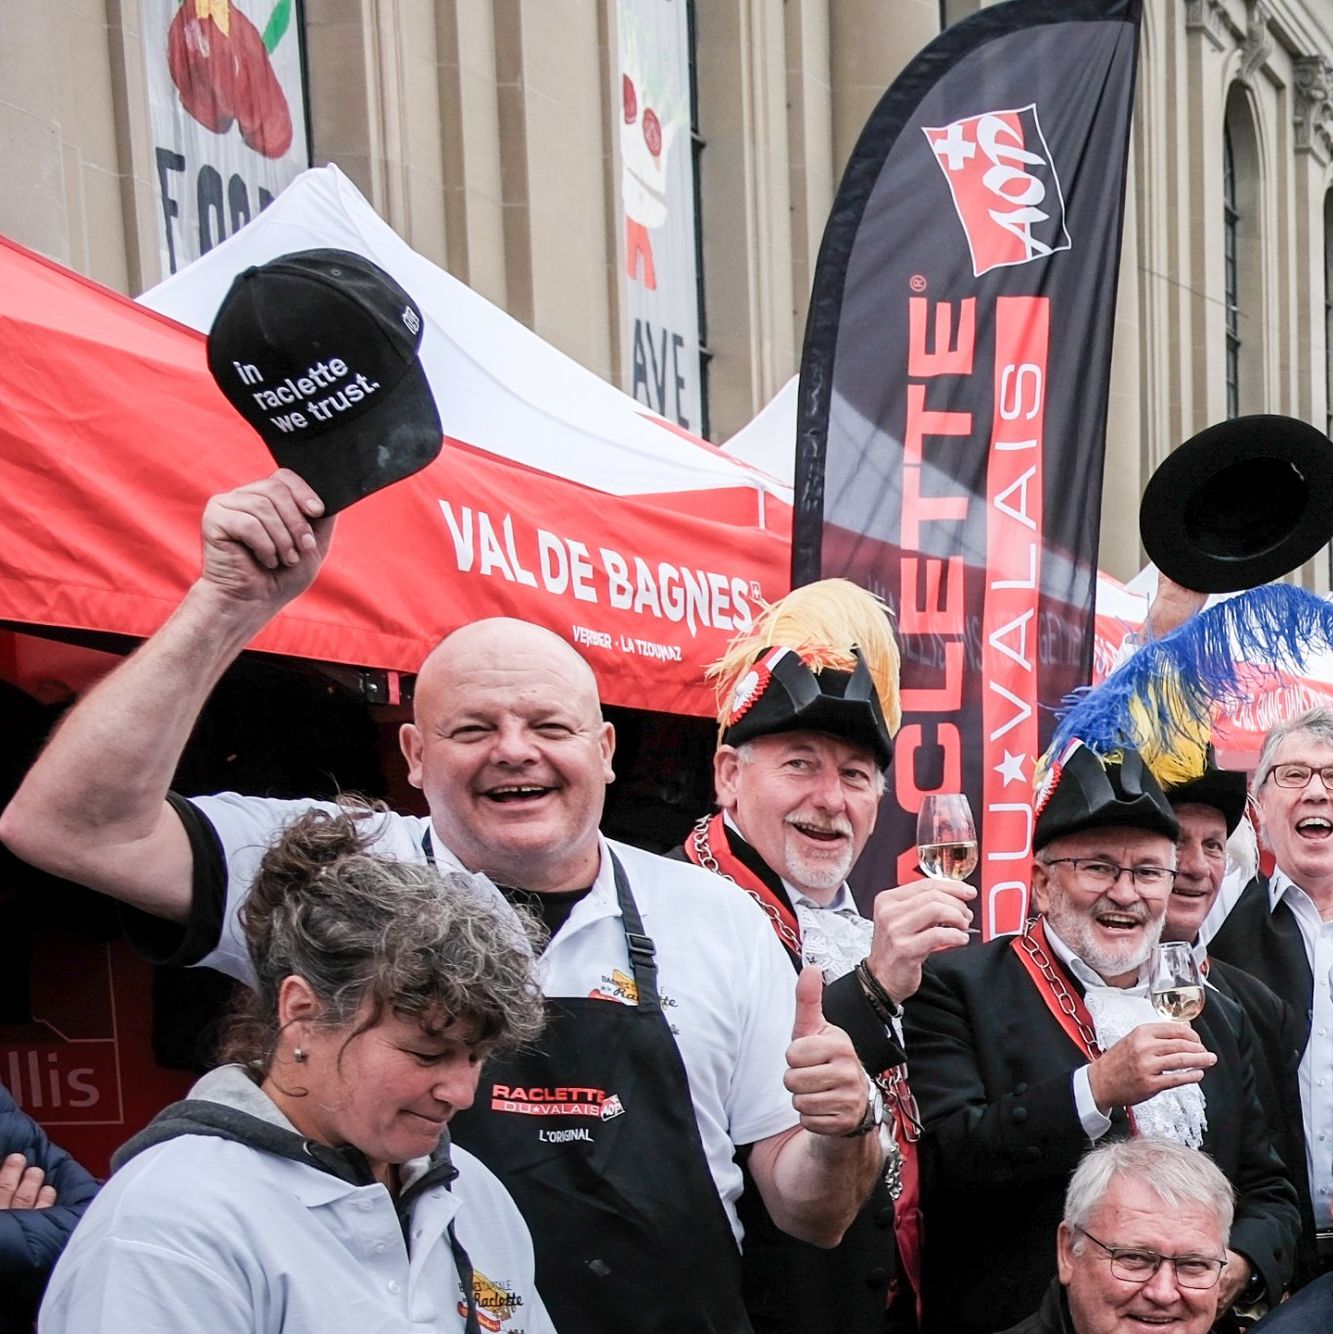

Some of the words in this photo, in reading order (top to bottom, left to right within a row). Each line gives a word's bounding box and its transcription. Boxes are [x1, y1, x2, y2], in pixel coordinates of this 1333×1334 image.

[976, 114, 1053, 260] AOP
[232, 360, 263, 386] in
[252, 357, 349, 411] raclette
[269, 411, 309, 433] we
[988, 363, 1043, 741] VALAIS
[438, 499, 537, 588] VAL
[537, 528, 598, 603] DE
[599, 547, 754, 638] BAGNES
[620, 636, 635, 654] LA
[987, 803, 1031, 941] DU
[493, 1084, 606, 1103] RACLETTE
[504, 1101, 531, 1114] DU
[540, 1104, 599, 1116] VALAIS
[539, 1128, 594, 1143] L'ORIGINAL
